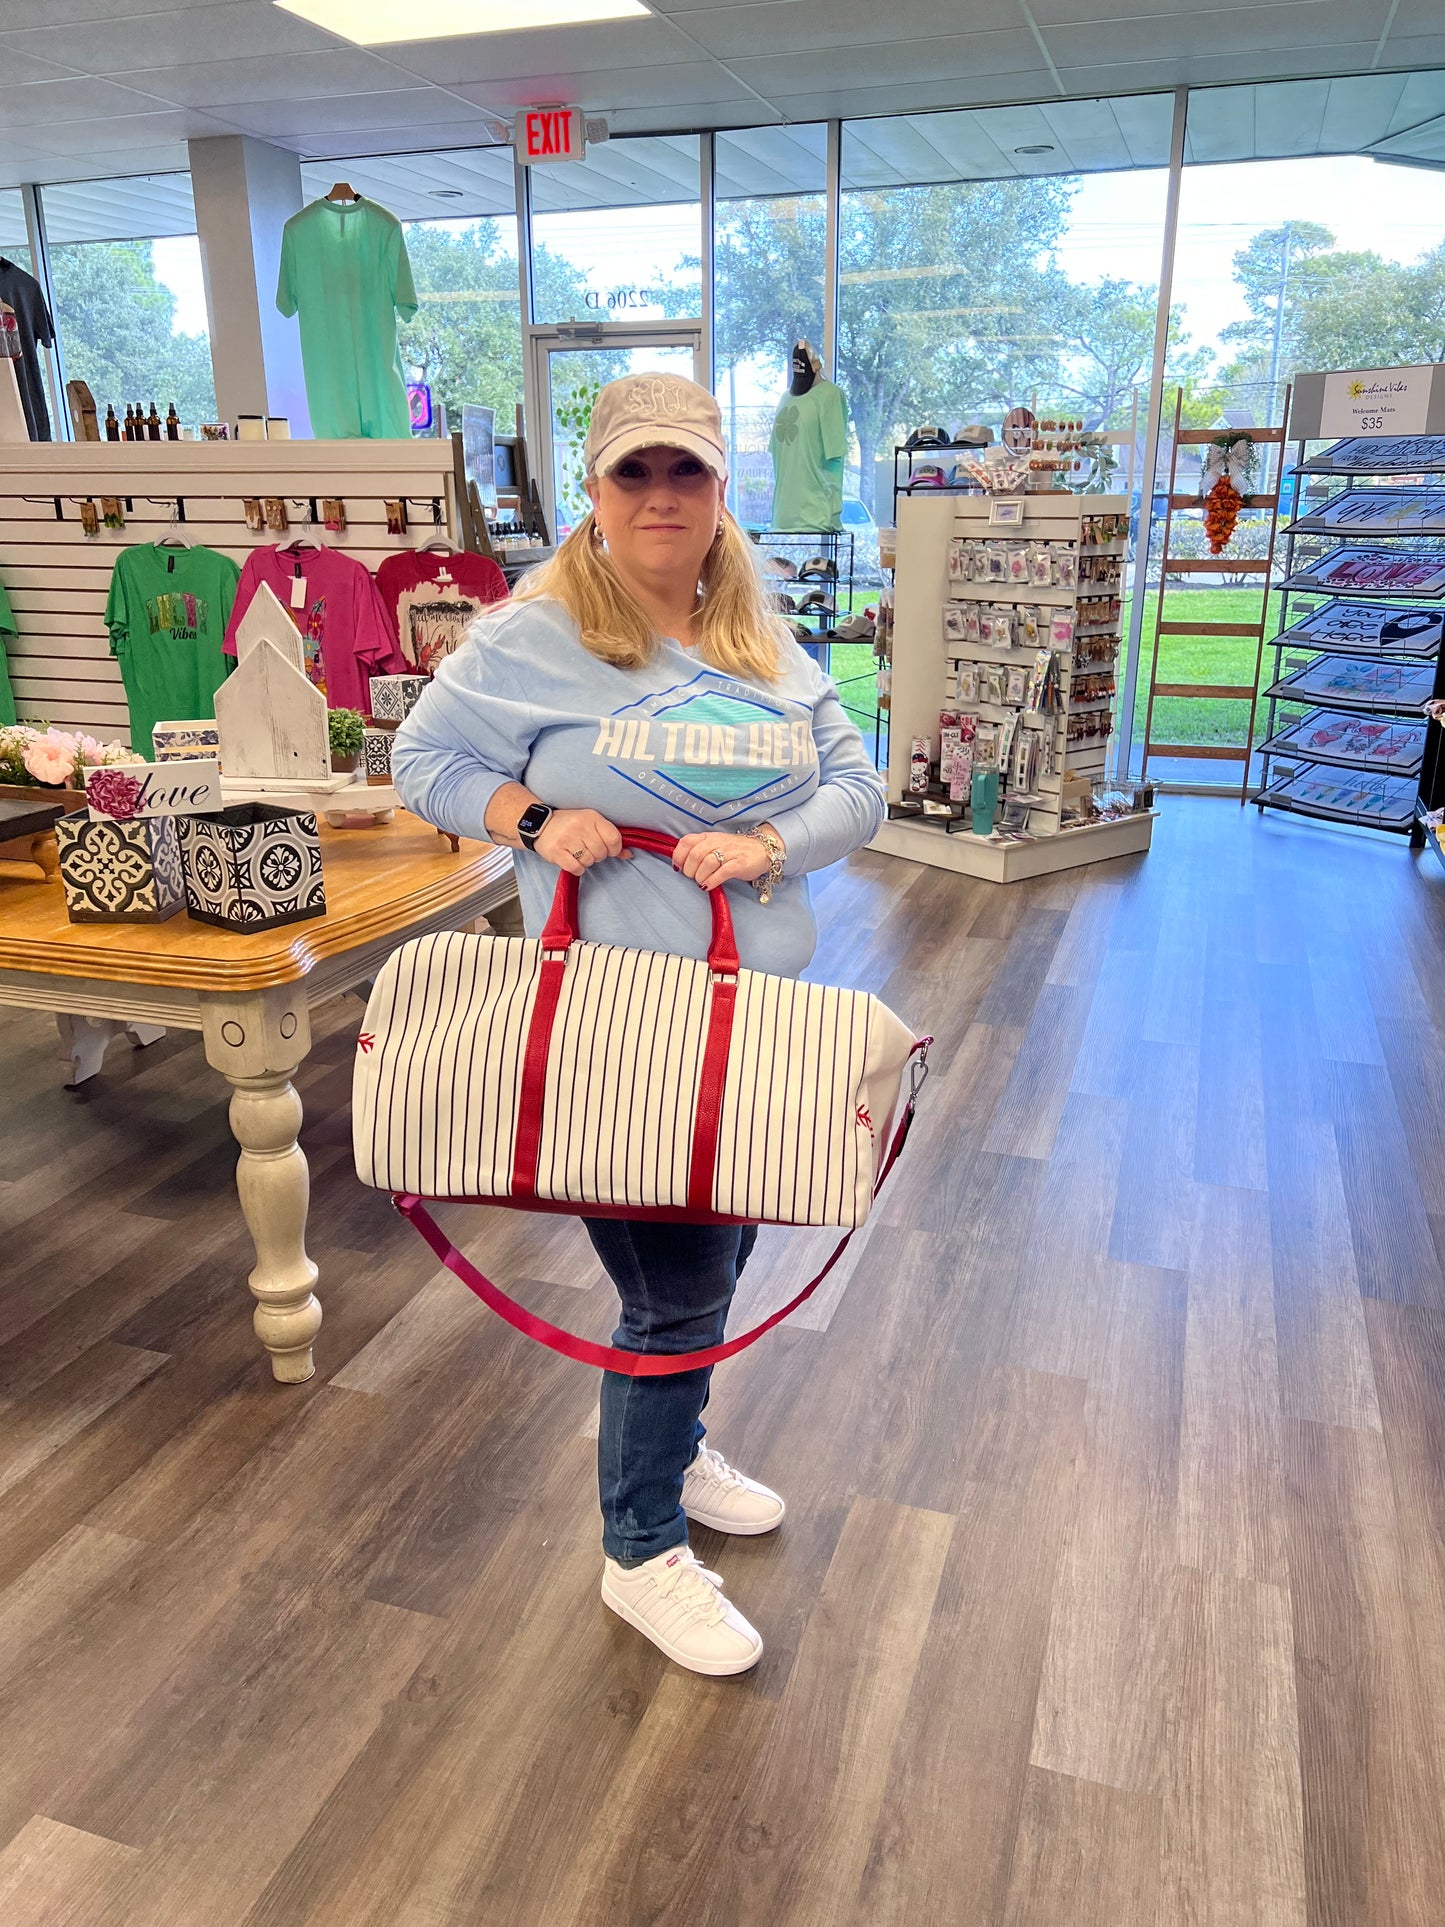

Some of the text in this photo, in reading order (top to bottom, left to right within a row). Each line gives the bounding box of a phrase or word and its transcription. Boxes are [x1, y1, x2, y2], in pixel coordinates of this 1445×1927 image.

[526, 111, 572, 156] EXIT
[1353, 380, 1408, 395] Sunshine Vibes
[1361, 416, 1383, 430] $35
[1326, 561, 1444, 585] LOVE
[592, 716, 736, 767] HILTON
[134, 772, 211, 809] love
[638, 770, 705, 815] OFFICIAL
